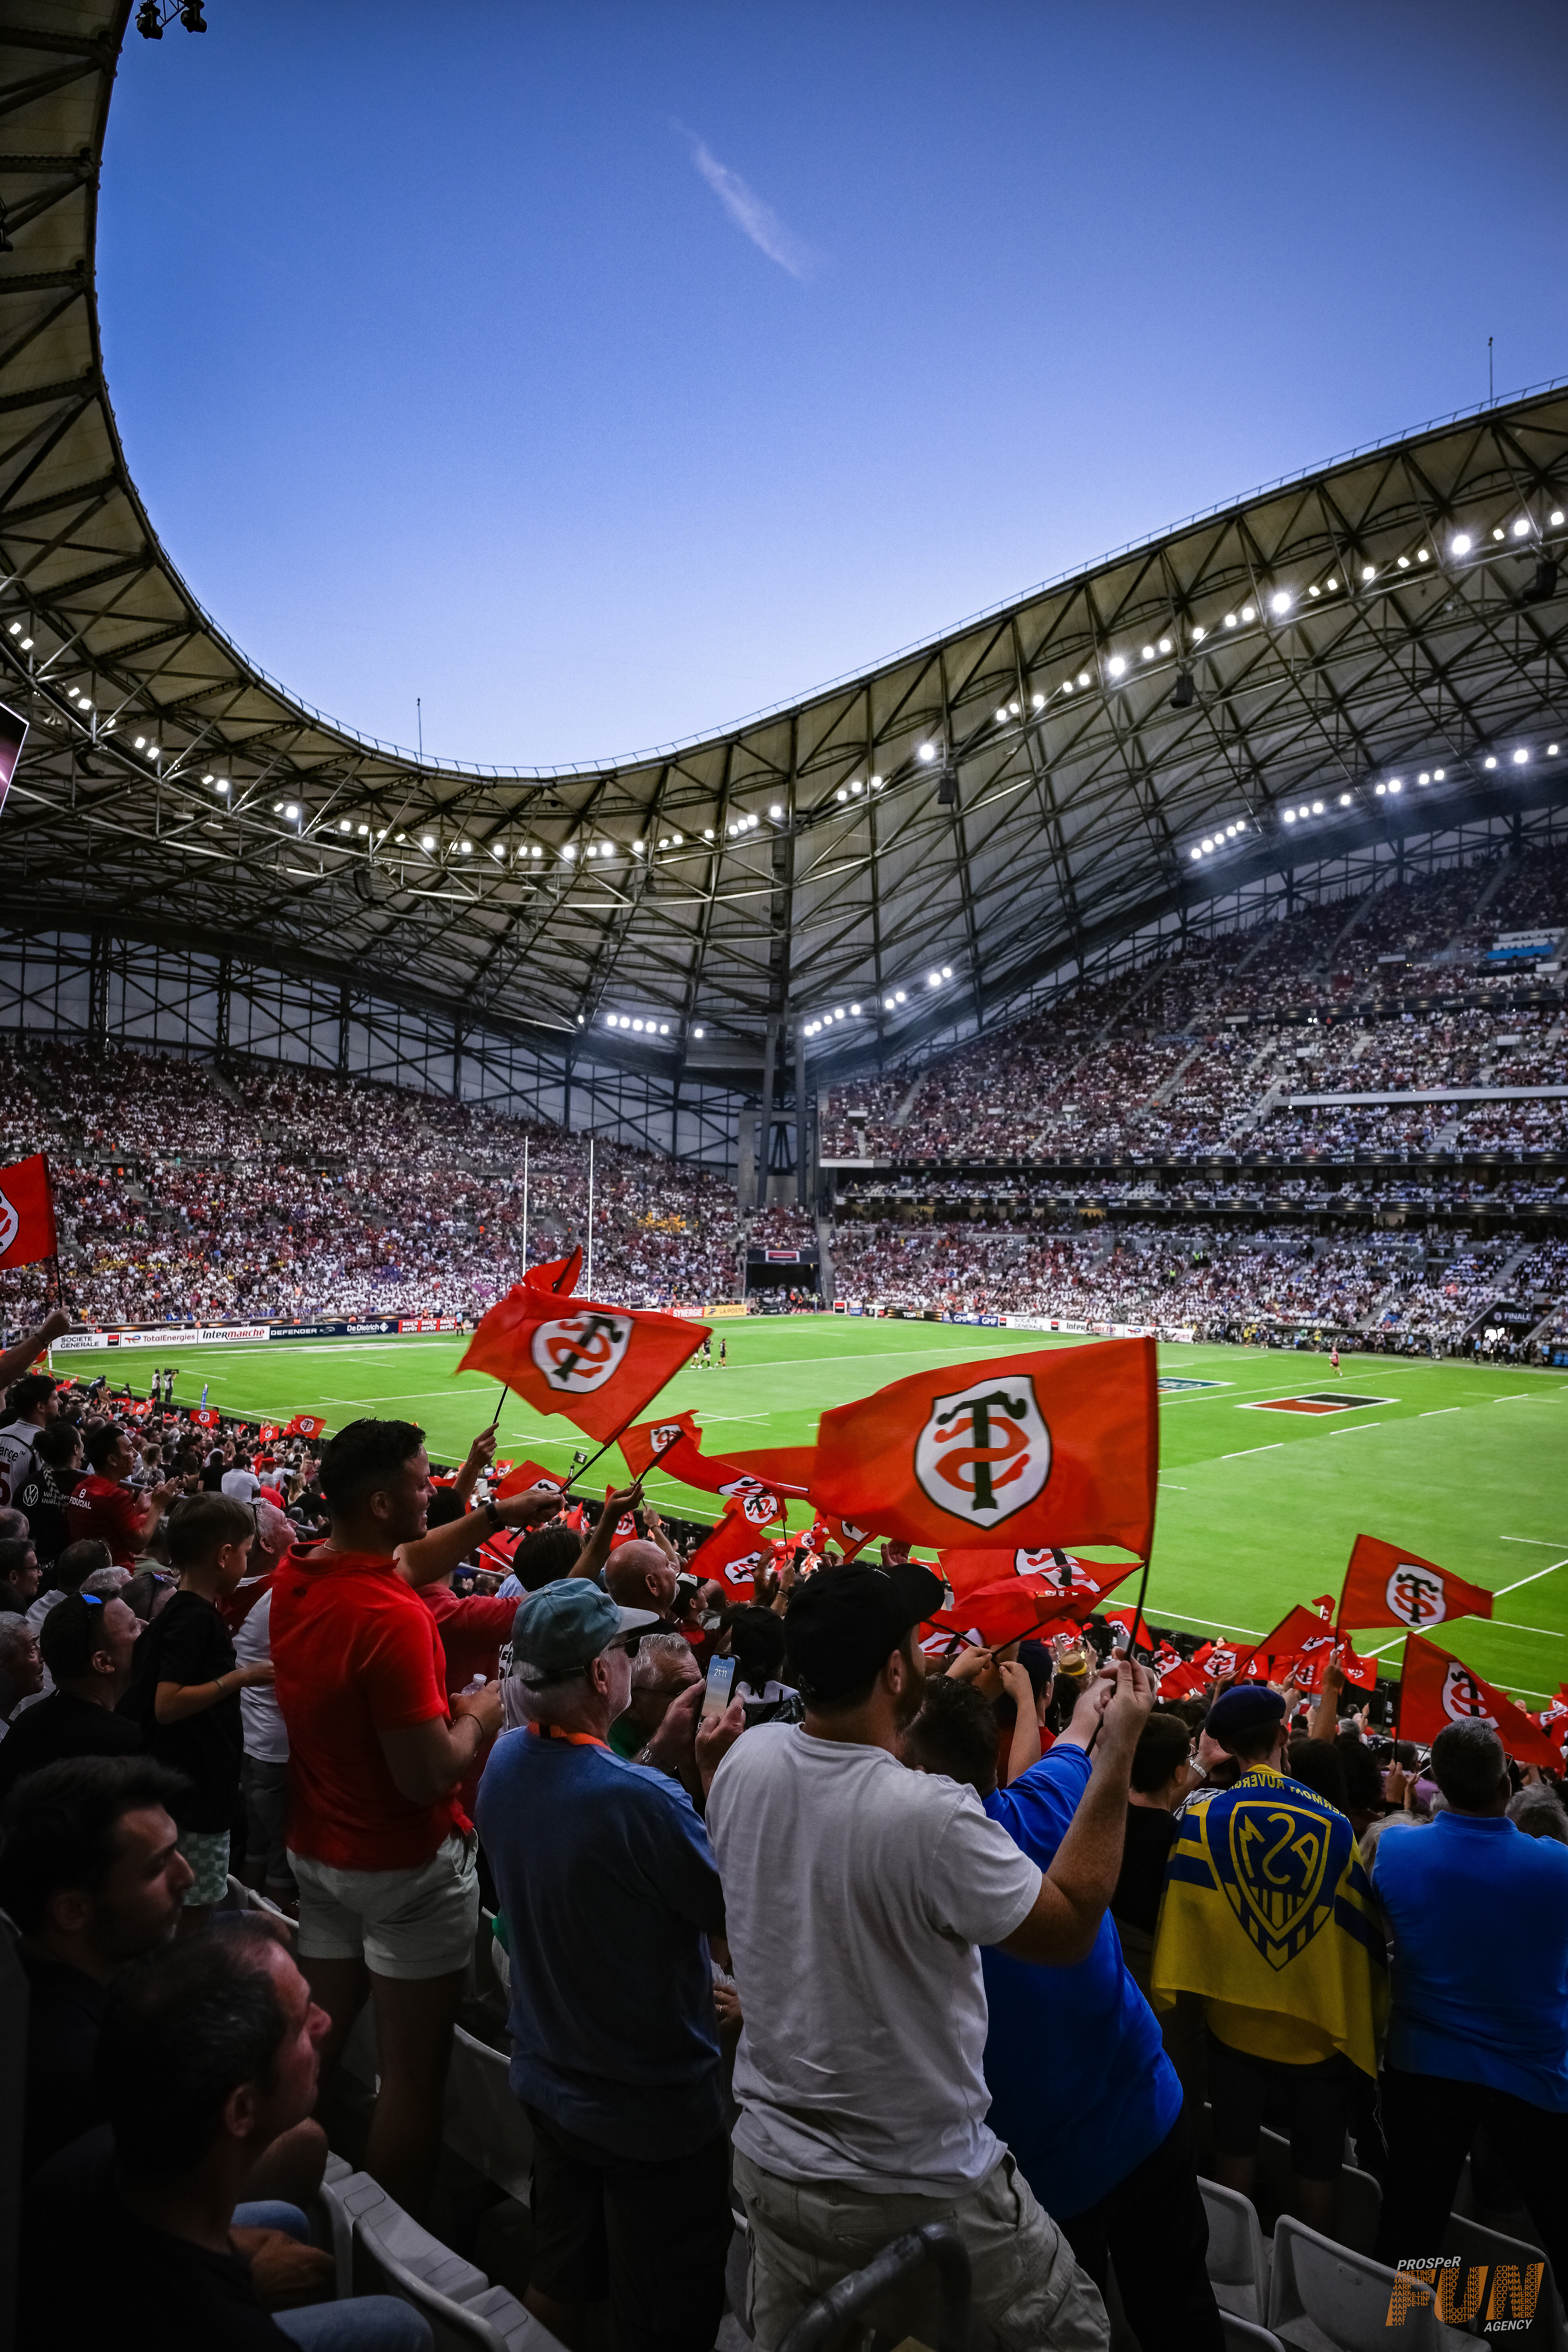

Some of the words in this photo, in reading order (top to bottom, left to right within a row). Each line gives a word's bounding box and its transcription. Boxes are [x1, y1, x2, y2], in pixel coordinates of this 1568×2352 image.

[673, 1308, 703, 1318] SYNERGIE
[982, 1317, 997, 1325] GMF
[270, 1328, 318, 1336] DEFENDER
[356, 1323, 379, 1332] Dietrich
[143, 1334, 196, 1343] TotalEnergies
[69, 1496, 91, 1510] FIDUCIAL
[713, 1668, 728, 1678] 21:11
